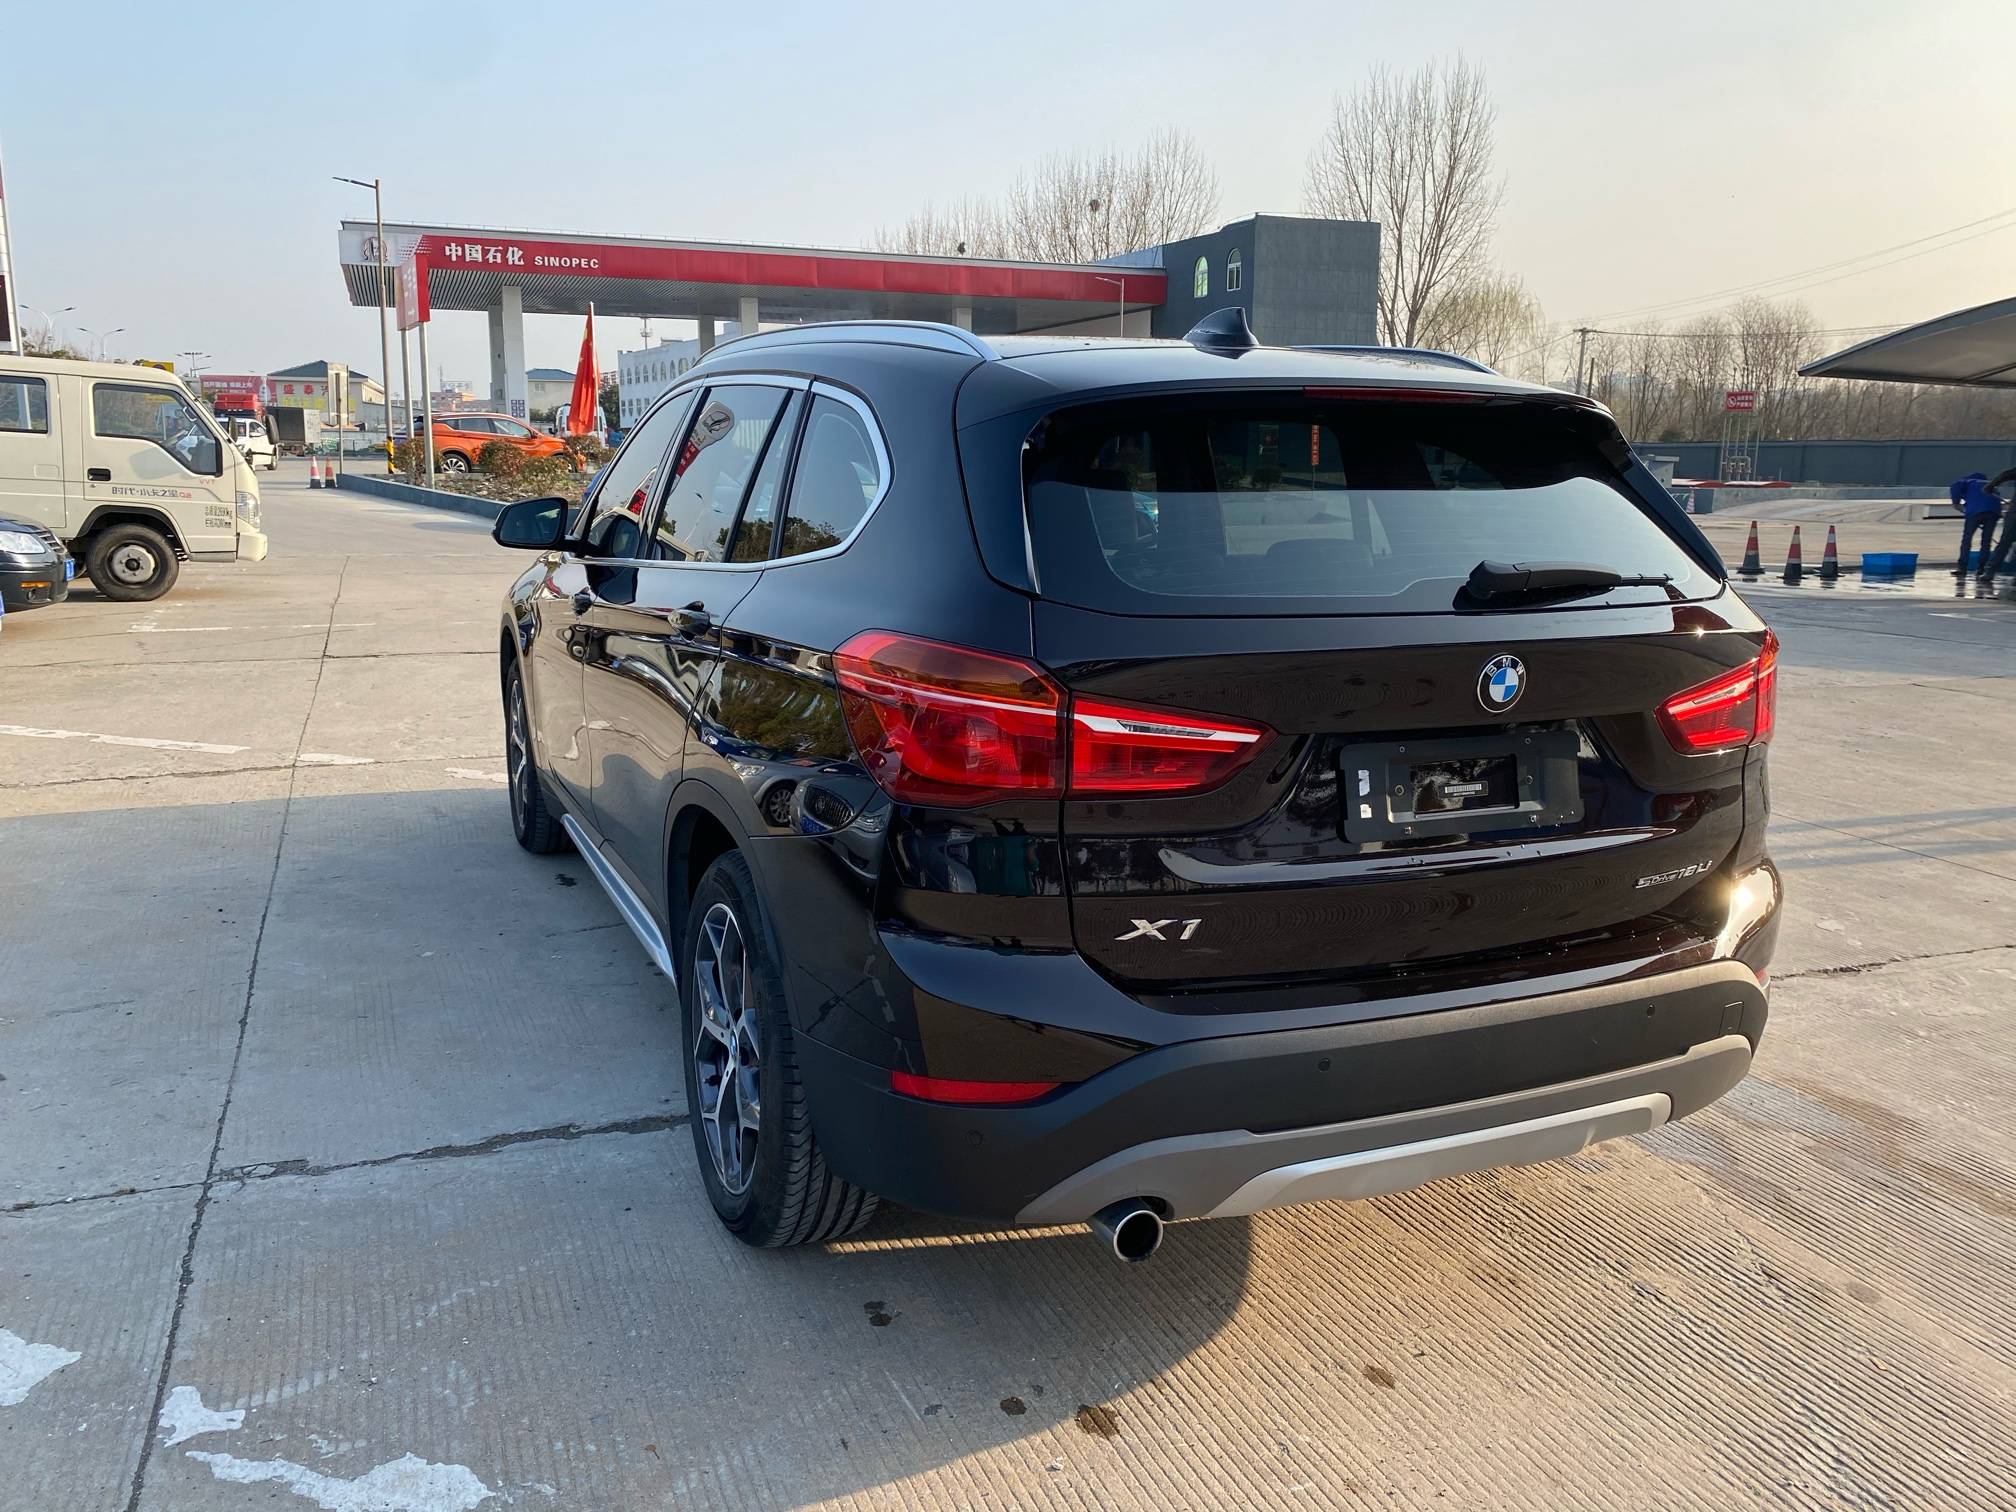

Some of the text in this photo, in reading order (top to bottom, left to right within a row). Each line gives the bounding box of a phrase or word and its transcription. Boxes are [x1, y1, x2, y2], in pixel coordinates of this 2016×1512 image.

[444, 242, 599, 269] 中国石化 SINOPEC
[1486, 657, 1524, 677] BMW
[1114, 919, 1202, 941] X1
